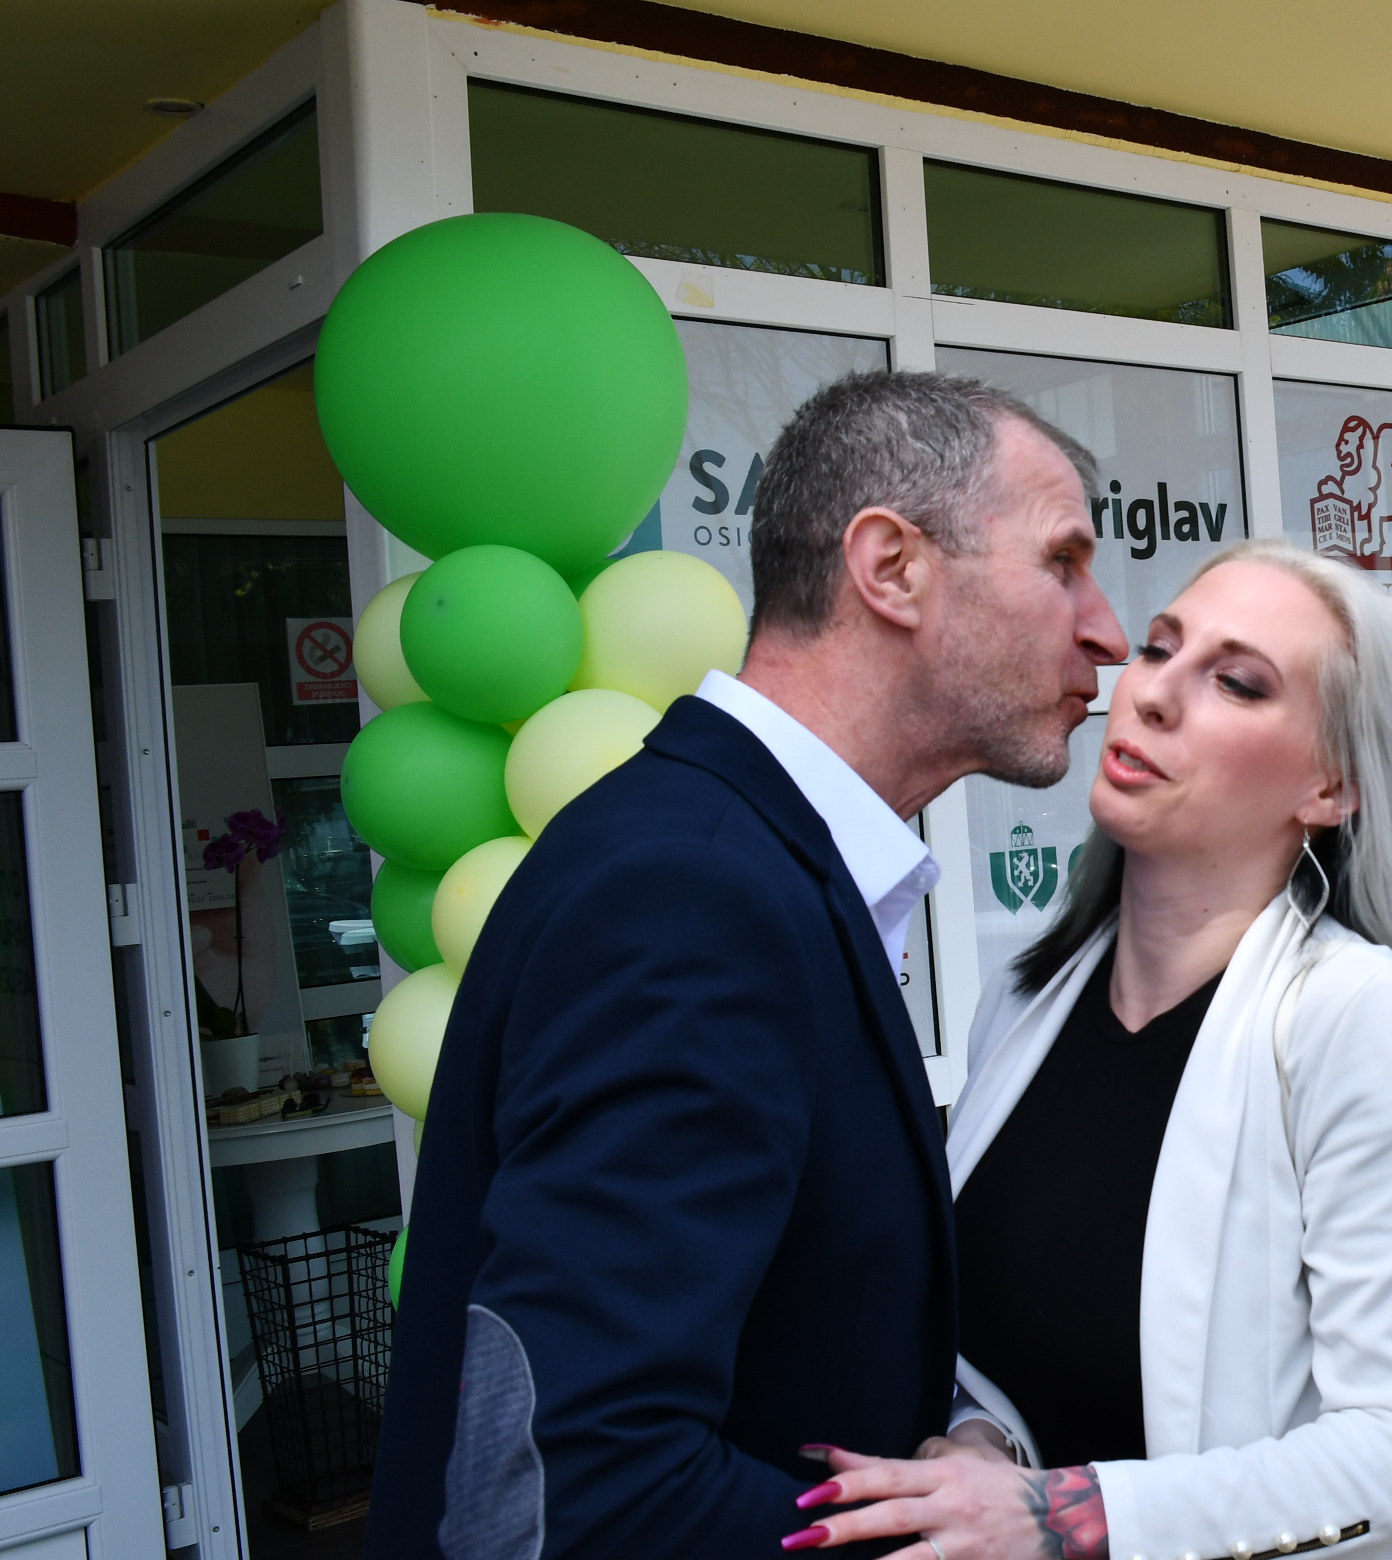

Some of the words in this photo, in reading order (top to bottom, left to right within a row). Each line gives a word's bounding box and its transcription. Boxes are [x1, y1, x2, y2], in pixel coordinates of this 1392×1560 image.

[689, 449, 765, 515] SA
[1316, 504, 1330, 516] PAX
[1333, 504, 1347, 516] VAN
[1091, 479, 1228, 560] riglav
[1317, 514, 1331, 525] TIBI
[1318, 523, 1333, 534] MAR
[1335, 523, 1348, 534] STA
[693, 525, 753, 547] OSI
